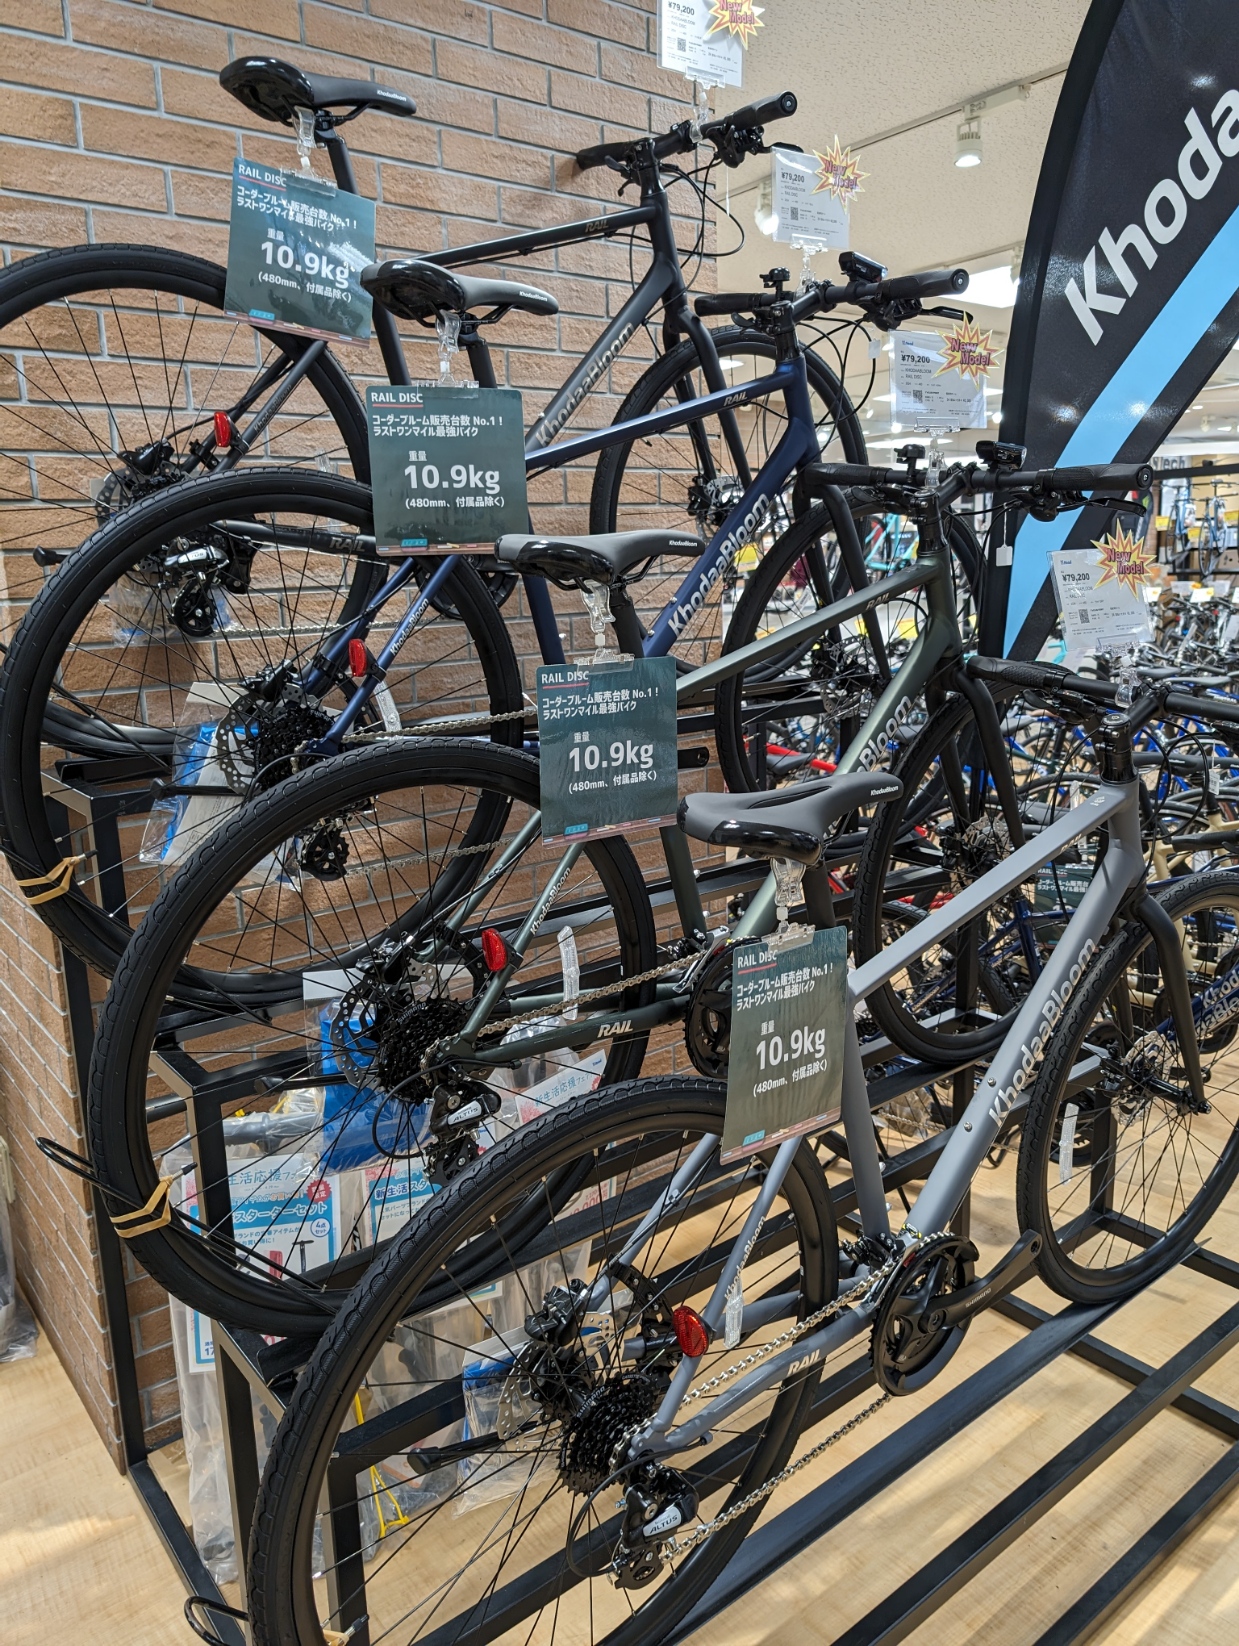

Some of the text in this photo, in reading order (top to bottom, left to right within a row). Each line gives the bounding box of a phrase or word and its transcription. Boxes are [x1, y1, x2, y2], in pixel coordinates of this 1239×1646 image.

[668, 1, 695, 16] ¥79,200
[720, 0, 743, 11] New
[729, 10, 755, 25] Model
[238, 164, 287, 188] RAIL DISC
[824, 160, 847, 176] New
[781, 172, 805, 183] ¥79,200
[833, 174, 858, 190] Model
[585, 220, 610, 233] RAIL
[267, 228, 285, 242] 重量
[261, 241, 350, 289] 10.9kg
[951, 338, 978, 352] New
[901, 354, 931, 365] ¥79,200
[961, 352, 991, 366] Model
[536, 322, 636, 448] KhodaaBloom
[371, 392, 423, 403] RAIL DISC
[724, 391, 748, 407] RAIL
[372, 414, 470, 426] コーダーブルーム販売台数
[373, 426, 479, 437] ラストワンマイル最強バイク
[409, 450, 427, 461] 重量
[404, 464, 500, 494] 10.9kg
[330, 537, 365, 552] RAIL
[1107, 548, 1132, 562] New
[668, 493, 770, 640] KhodaaBloom
[1117, 561, 1145, 575] Model
[1062, 573, 1090, 583] ¥79,200
[389, 598, 429, 656] KhodaaBloom
[541, 671, 589, 684] RAIL DISC
[542, 689, 630, 709] コーダーブルーム販売台数
[543, 700, 637, 720] ラストワンマイル最強バイク
[573, 731, 590, 744] 重量
[569, 739, 654, 772] 10.9kg
[530, 867, 571, 936] KhodaaBloom
[737, 950, 778, 969] RAIL DISC
[736, 967, 810, 997] コーダーブルーム販売台数
[736, 979, 815, 1012] ラストワンマイル最強バイク
[597, 1019, 634, 1038] RAIL
[760, 1020, 775, 1036] 重量
[988, 937, 1096, 1127] KhodaaBloom
[756, 1026, 826, 1070] 10.9kg
[786, 1348, 821, 1378] RAIL
[649, 1516, 678, 1534] ALTUS
